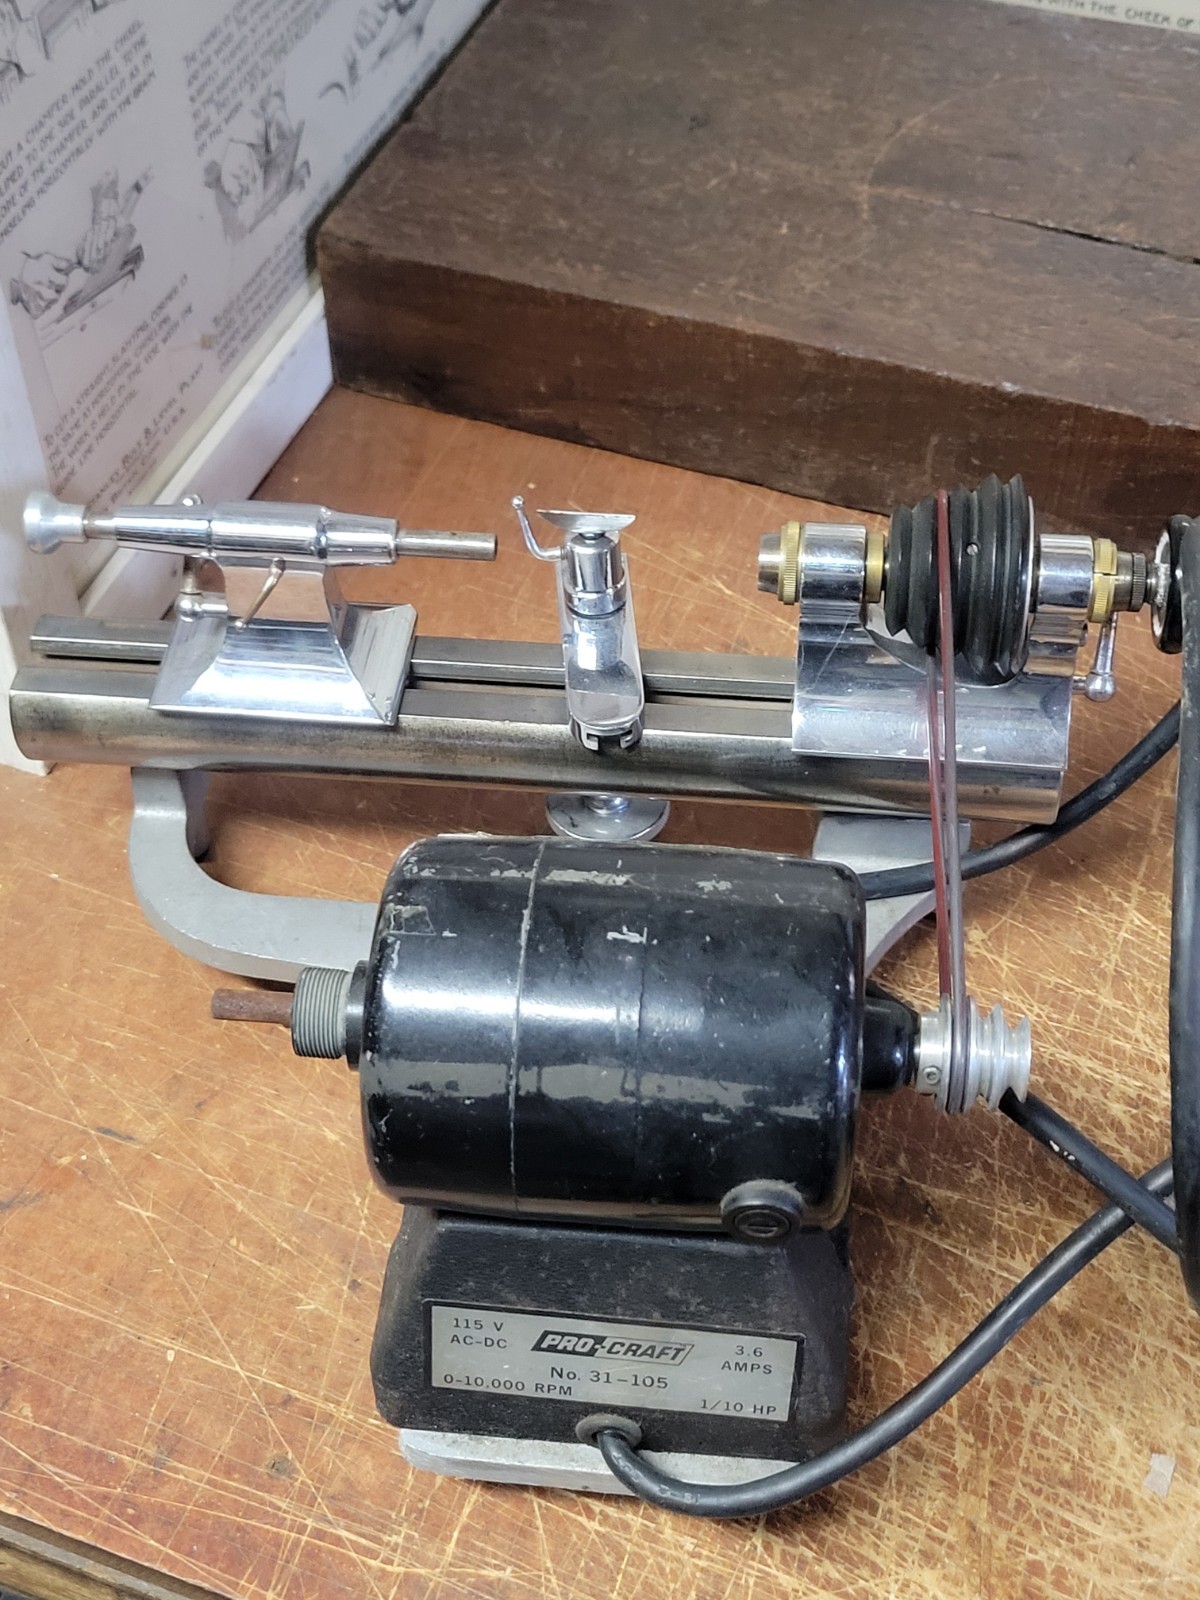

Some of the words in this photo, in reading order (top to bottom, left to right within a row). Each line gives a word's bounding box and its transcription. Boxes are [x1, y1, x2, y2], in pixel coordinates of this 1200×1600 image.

[1090, 1, 1116, 15] THE
[23, 92, 69, 145] CHAMFER
[95, 48, 112, 70] THE
[453, 1318, 484, 1330] 115
[493, 1321, 504, 1332] V
[450, 1334, 508, 1349] AC-DC
[735, 1345, 763, 1358] 3.6
[720, 1360, 773, 1375] AMPS
[550, 1366, 581, 1381] No.
[589, 1370, 669, 1389] 31-105
[534, 1383, 573, 1396] RPM
[700, 1399, 744, 1413] 1/10
[752, 1404, 777, 1415] HP
